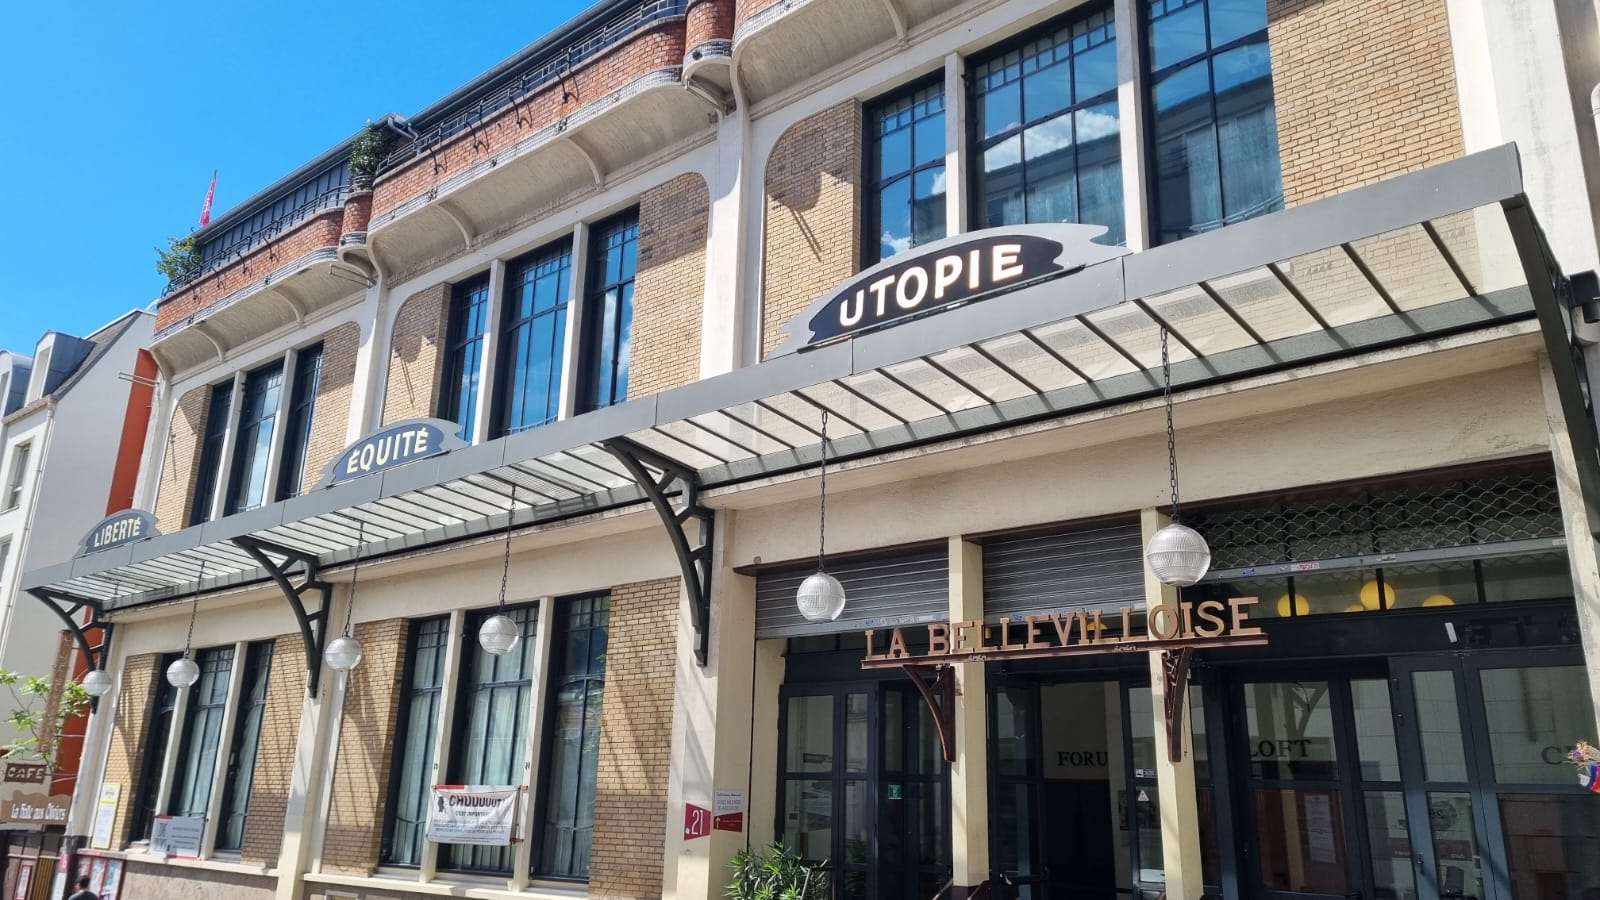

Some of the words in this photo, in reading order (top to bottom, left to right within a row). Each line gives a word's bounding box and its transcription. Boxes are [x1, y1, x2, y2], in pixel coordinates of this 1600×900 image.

[838, 243, 1025, 328] UTOPIE
[345, 426, 430, 474] ÉQUITÉ
[94, 517, 141, 548] LIBERTÉ
[864, 627, 910, 660] LA
[927, 596, 1262, 655] BELLEVILLOISE
[1056, 751, 1109, 767] FORU
